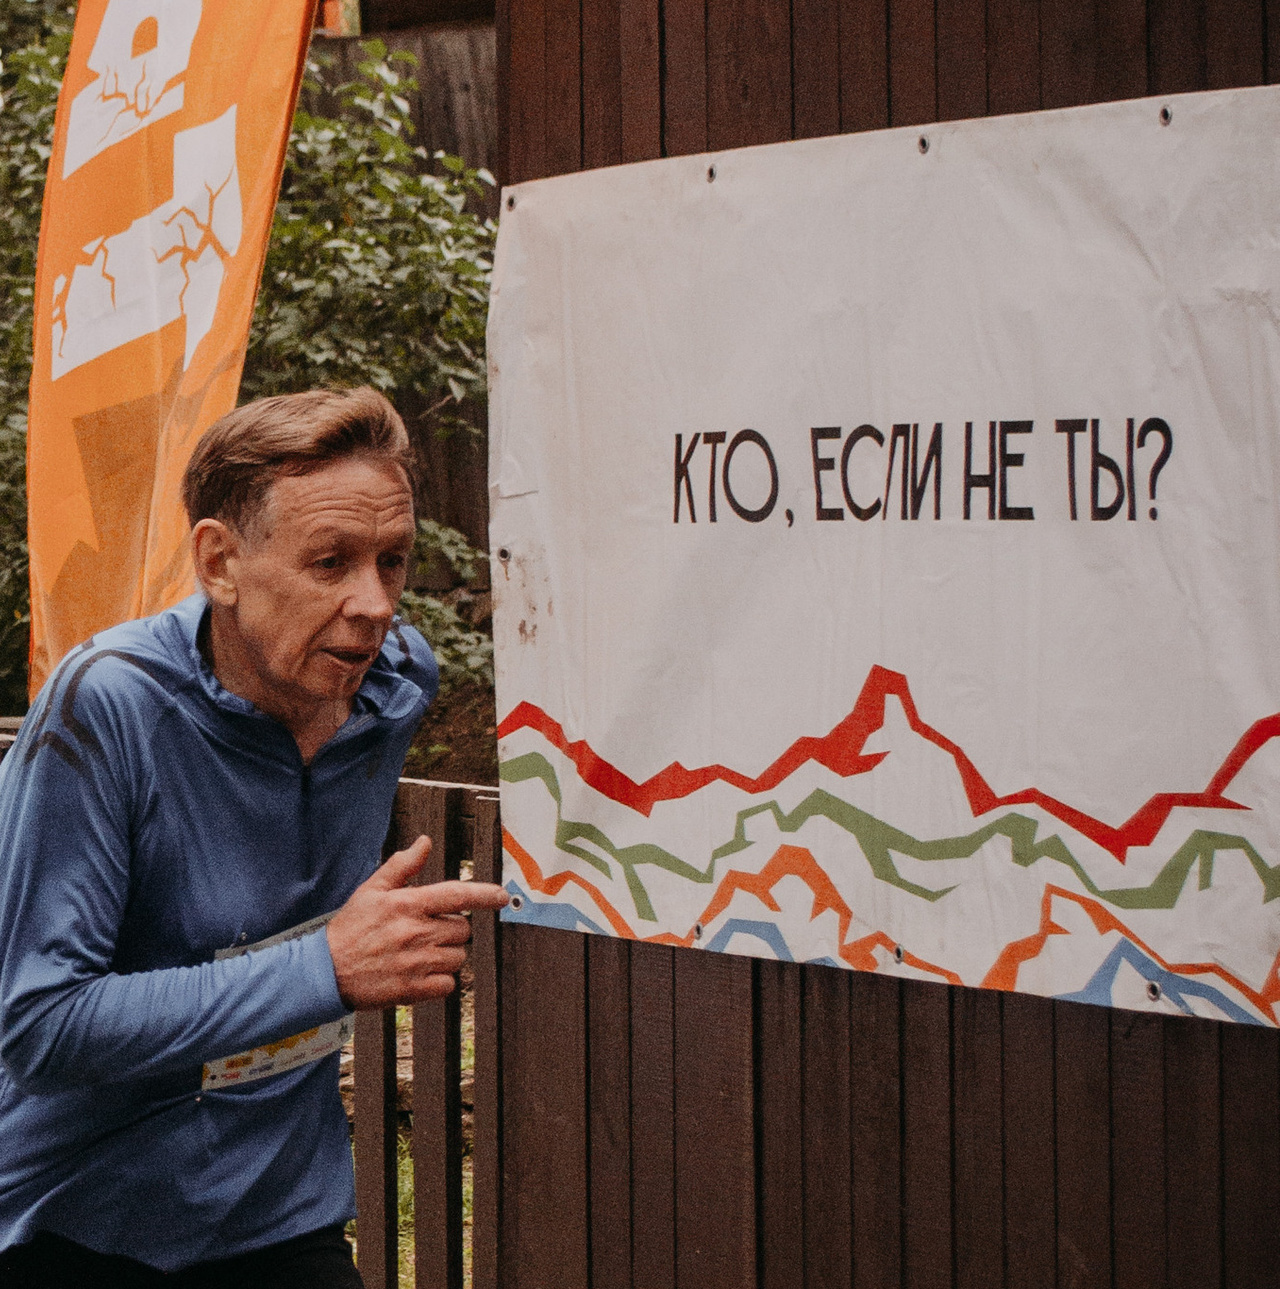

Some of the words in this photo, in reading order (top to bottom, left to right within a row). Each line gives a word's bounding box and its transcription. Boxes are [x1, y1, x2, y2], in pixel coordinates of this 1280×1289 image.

[672, 428, 794, 527] КТО,
[810, 423, 943, 522] ЕСЛИ
[963, 420, 1035, 521] НЕ
[1055, 417, 1173, 521] ТЫ?
